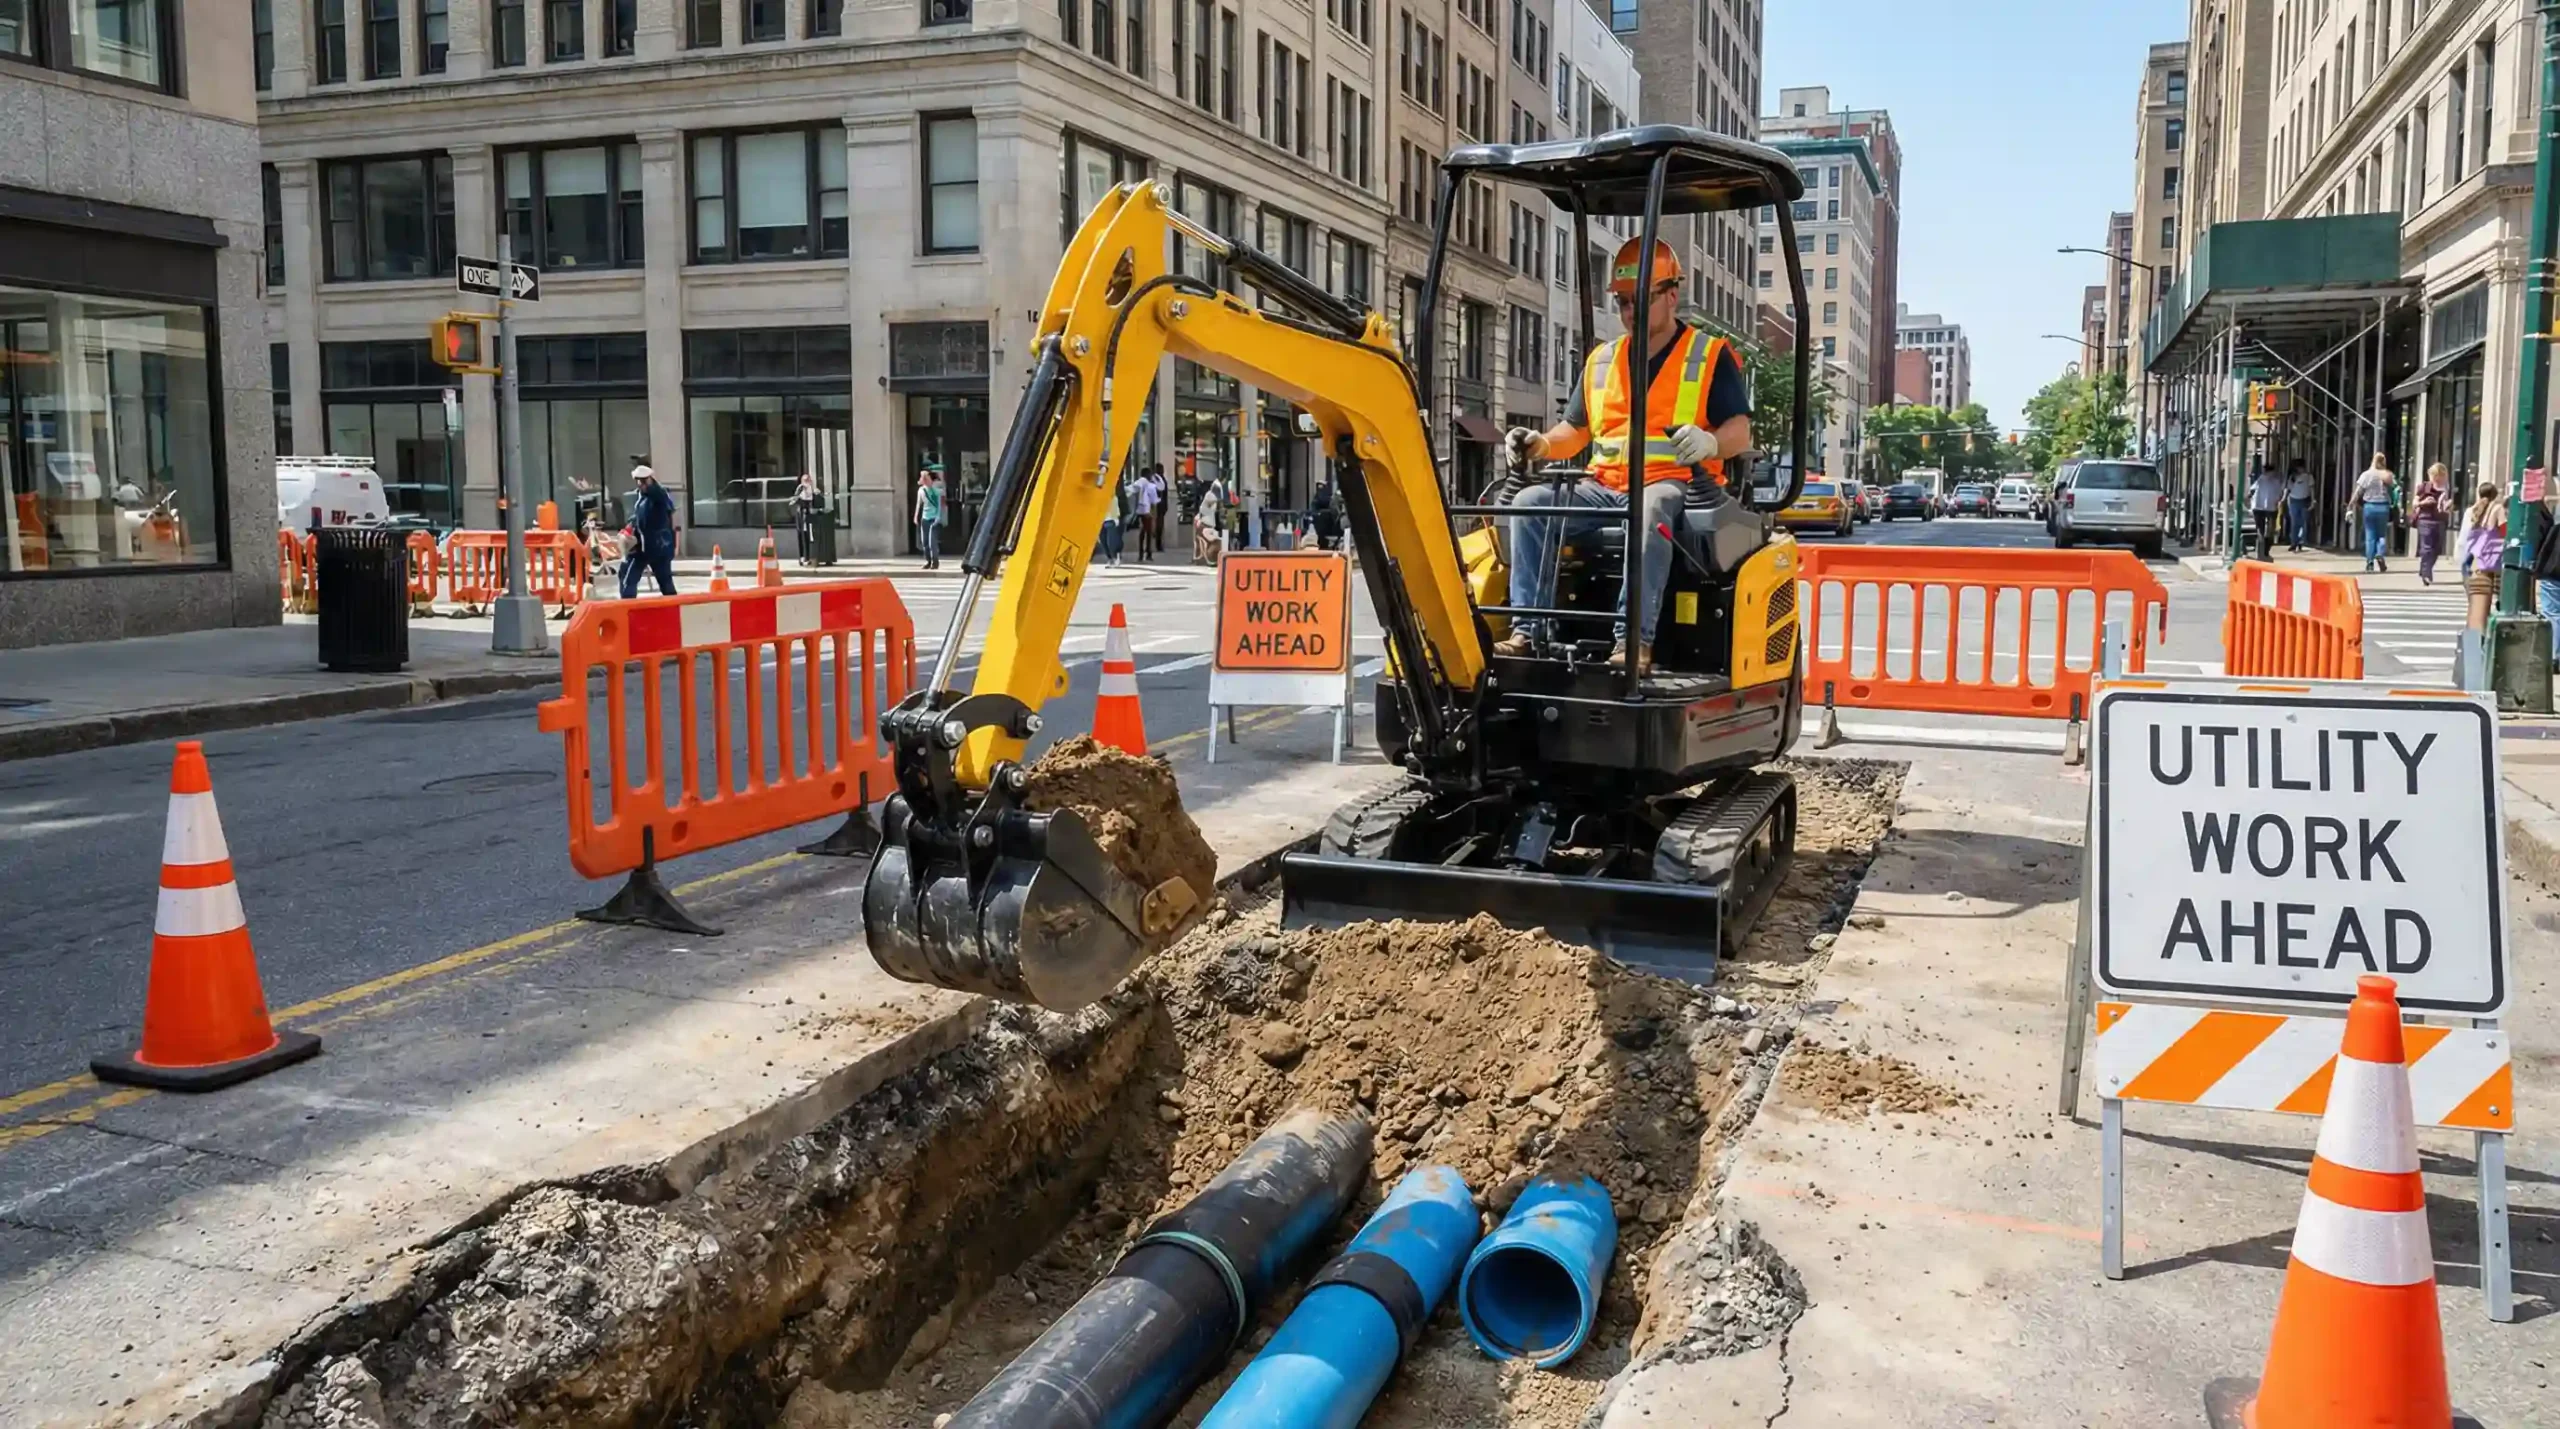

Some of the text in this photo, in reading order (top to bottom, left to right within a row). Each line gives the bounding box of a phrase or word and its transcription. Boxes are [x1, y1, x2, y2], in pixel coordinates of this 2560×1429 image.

[467, 268, 490, 285] ONE
[1235, 569, 1333, 592] UTILITY
[1246, 601, 1319, 624] WORK
[1236, 633, 1325, 656] AHEAD
[2149, 723, 2438, 795] UTILITY
[2181, 811, 2406, 883] WORK
[2160, 898, 2432, 974] AHEAD
